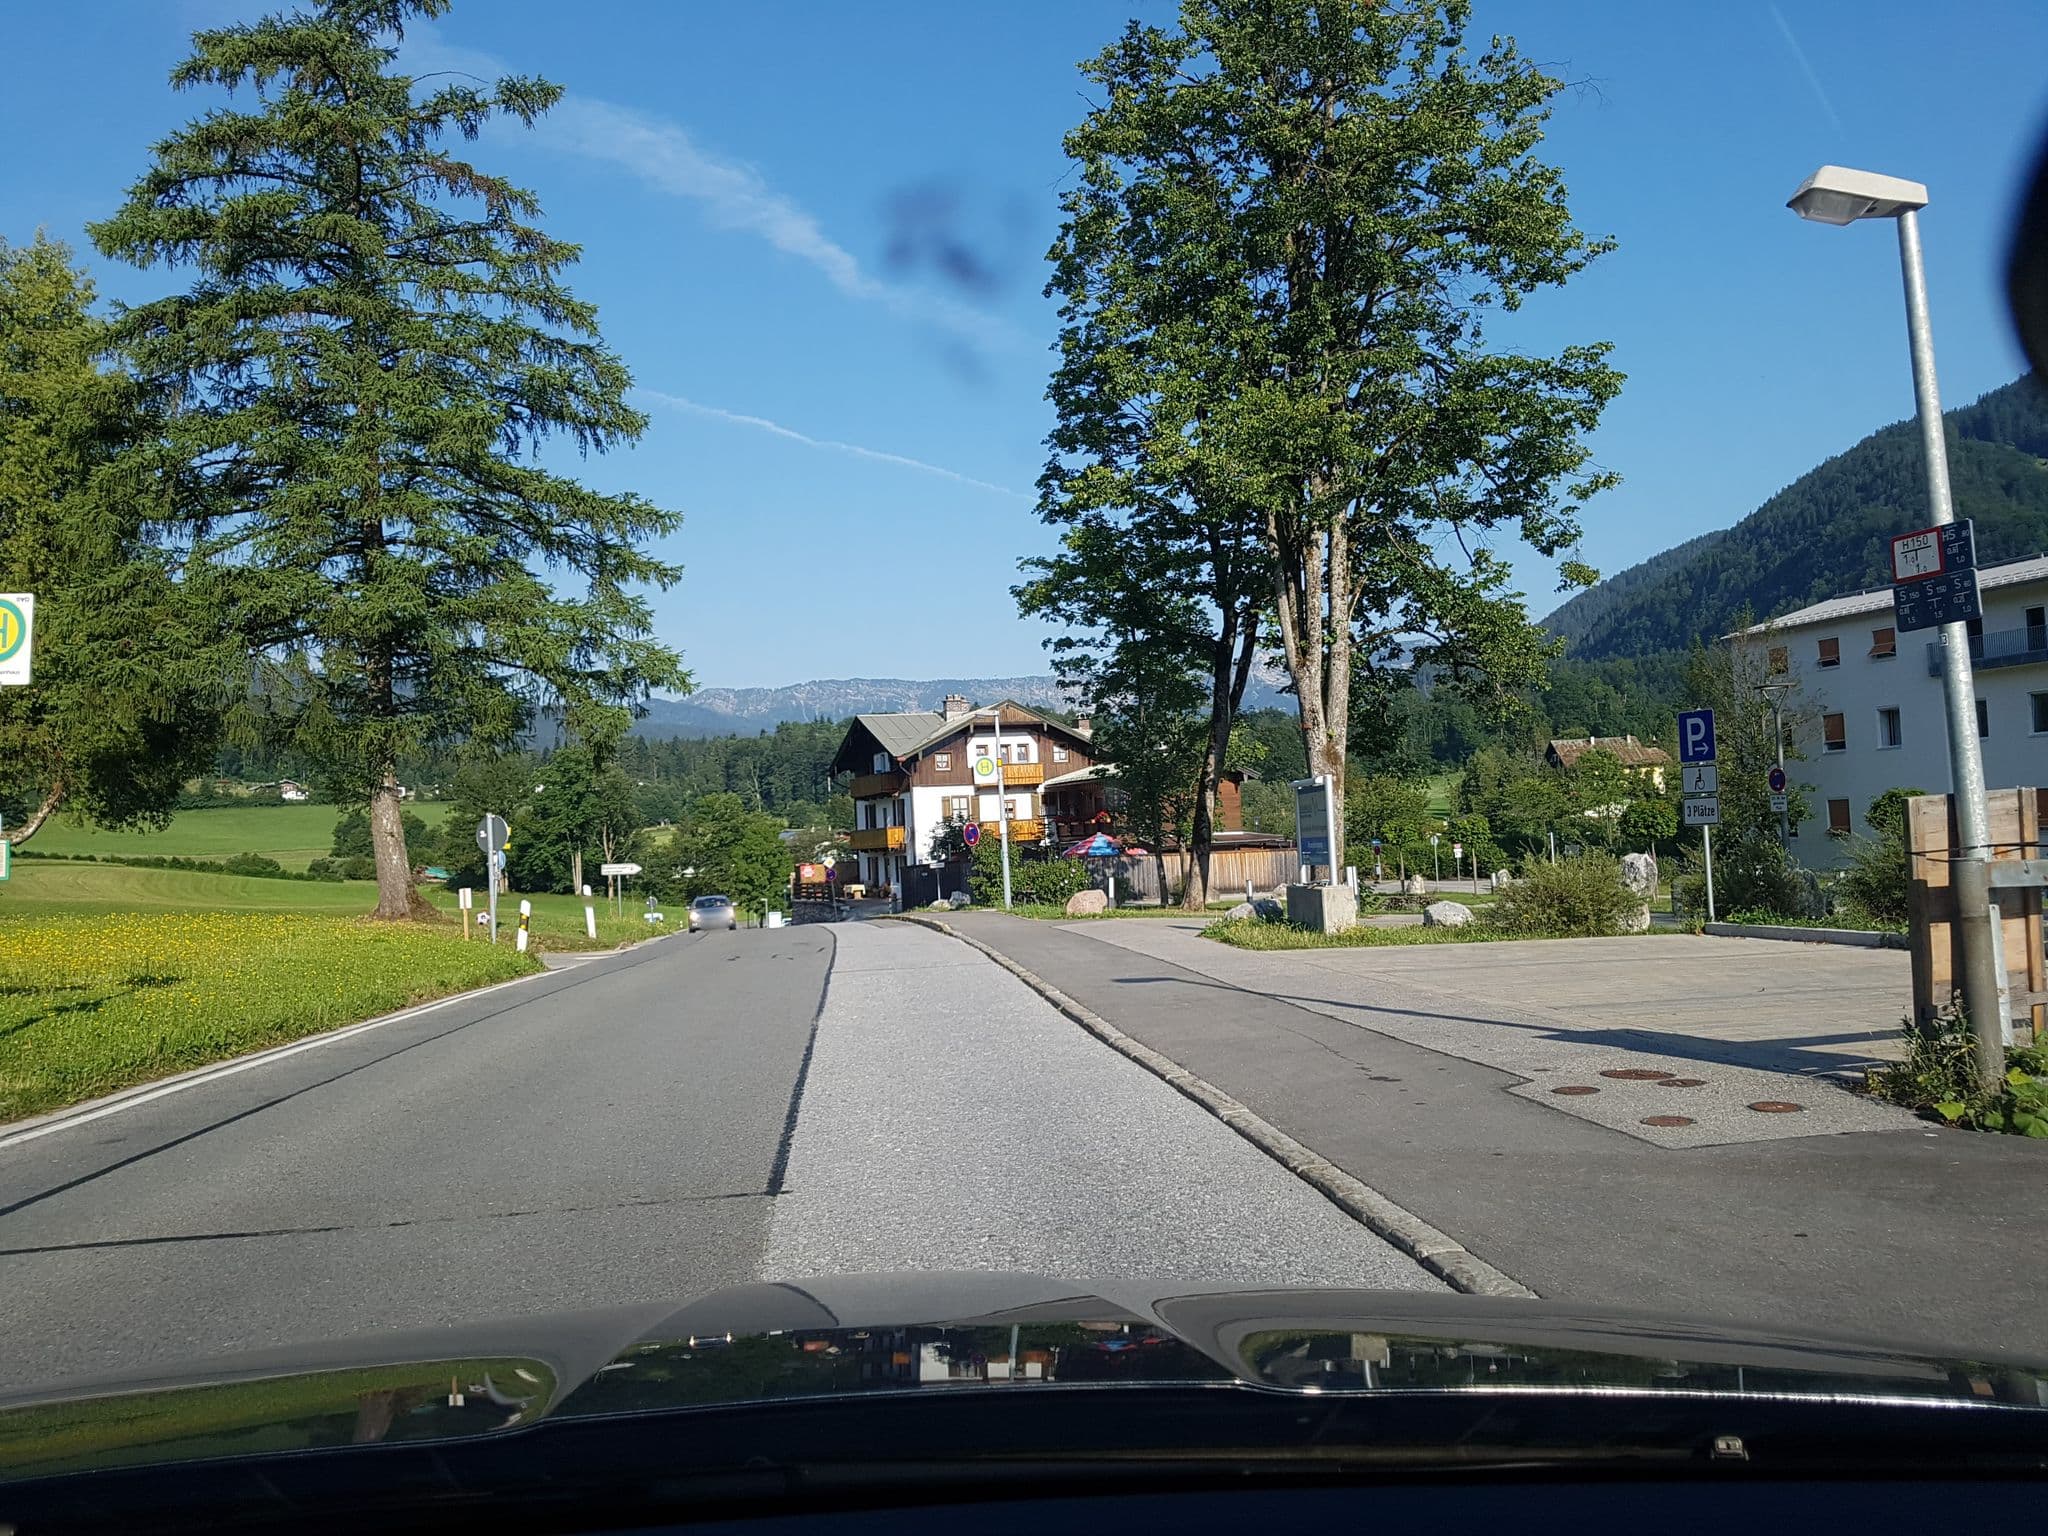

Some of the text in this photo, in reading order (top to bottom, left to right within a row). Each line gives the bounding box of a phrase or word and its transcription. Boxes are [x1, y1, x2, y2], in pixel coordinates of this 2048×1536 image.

[1686, 717, 1706, 756] P
[1687, 804, 1715, 817] 3 Plätze
